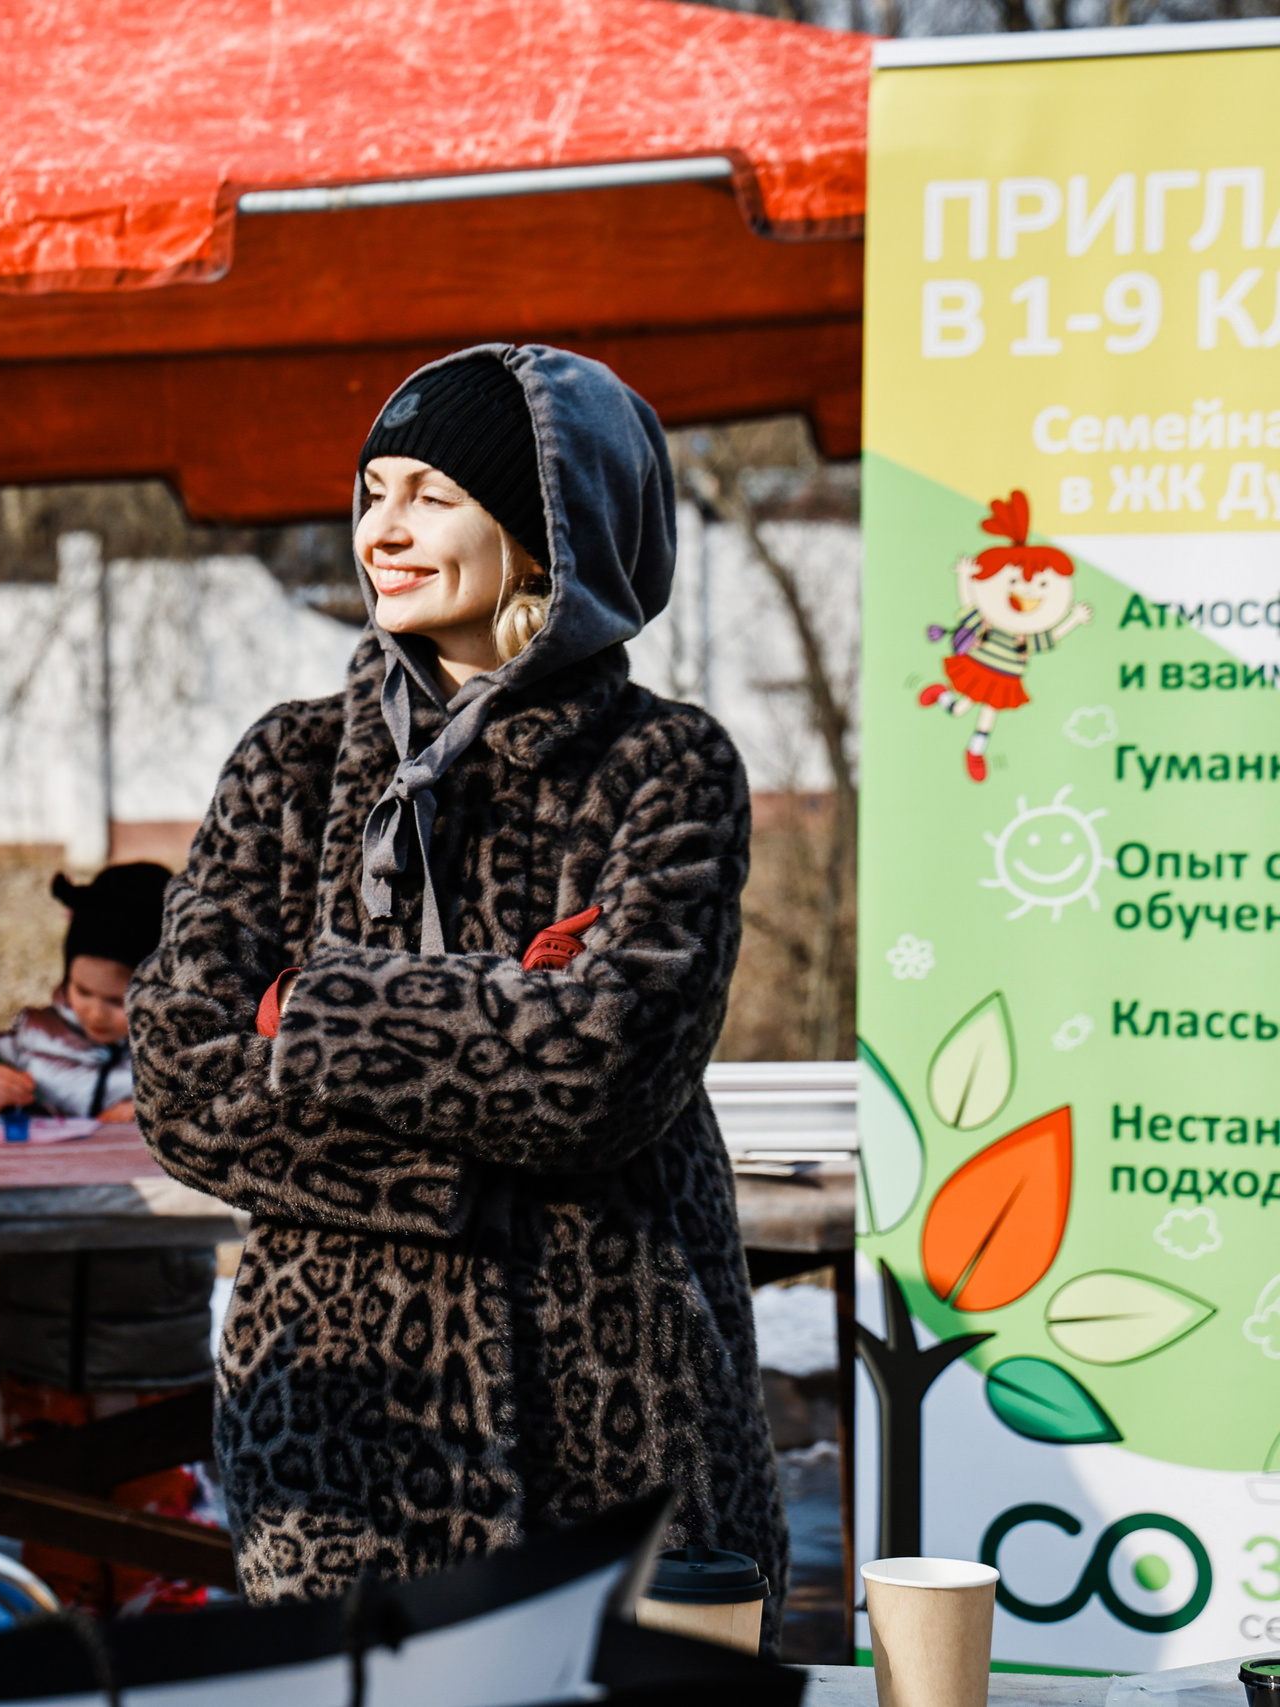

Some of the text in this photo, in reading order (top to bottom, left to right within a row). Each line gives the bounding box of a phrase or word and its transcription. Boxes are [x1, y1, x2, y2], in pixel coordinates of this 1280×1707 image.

[922, 165, 1280, 263] ПРИГЛ
[921, 278, 986, 359] В
[1009, 270, 1163, 358] 1-9
[1059, 475, 1094, 514] в
[1106, 462, 1206, 513] ЖК
[1120, 662, 1146, 690] и
[1117, 842, 1248, 880] Опыт
